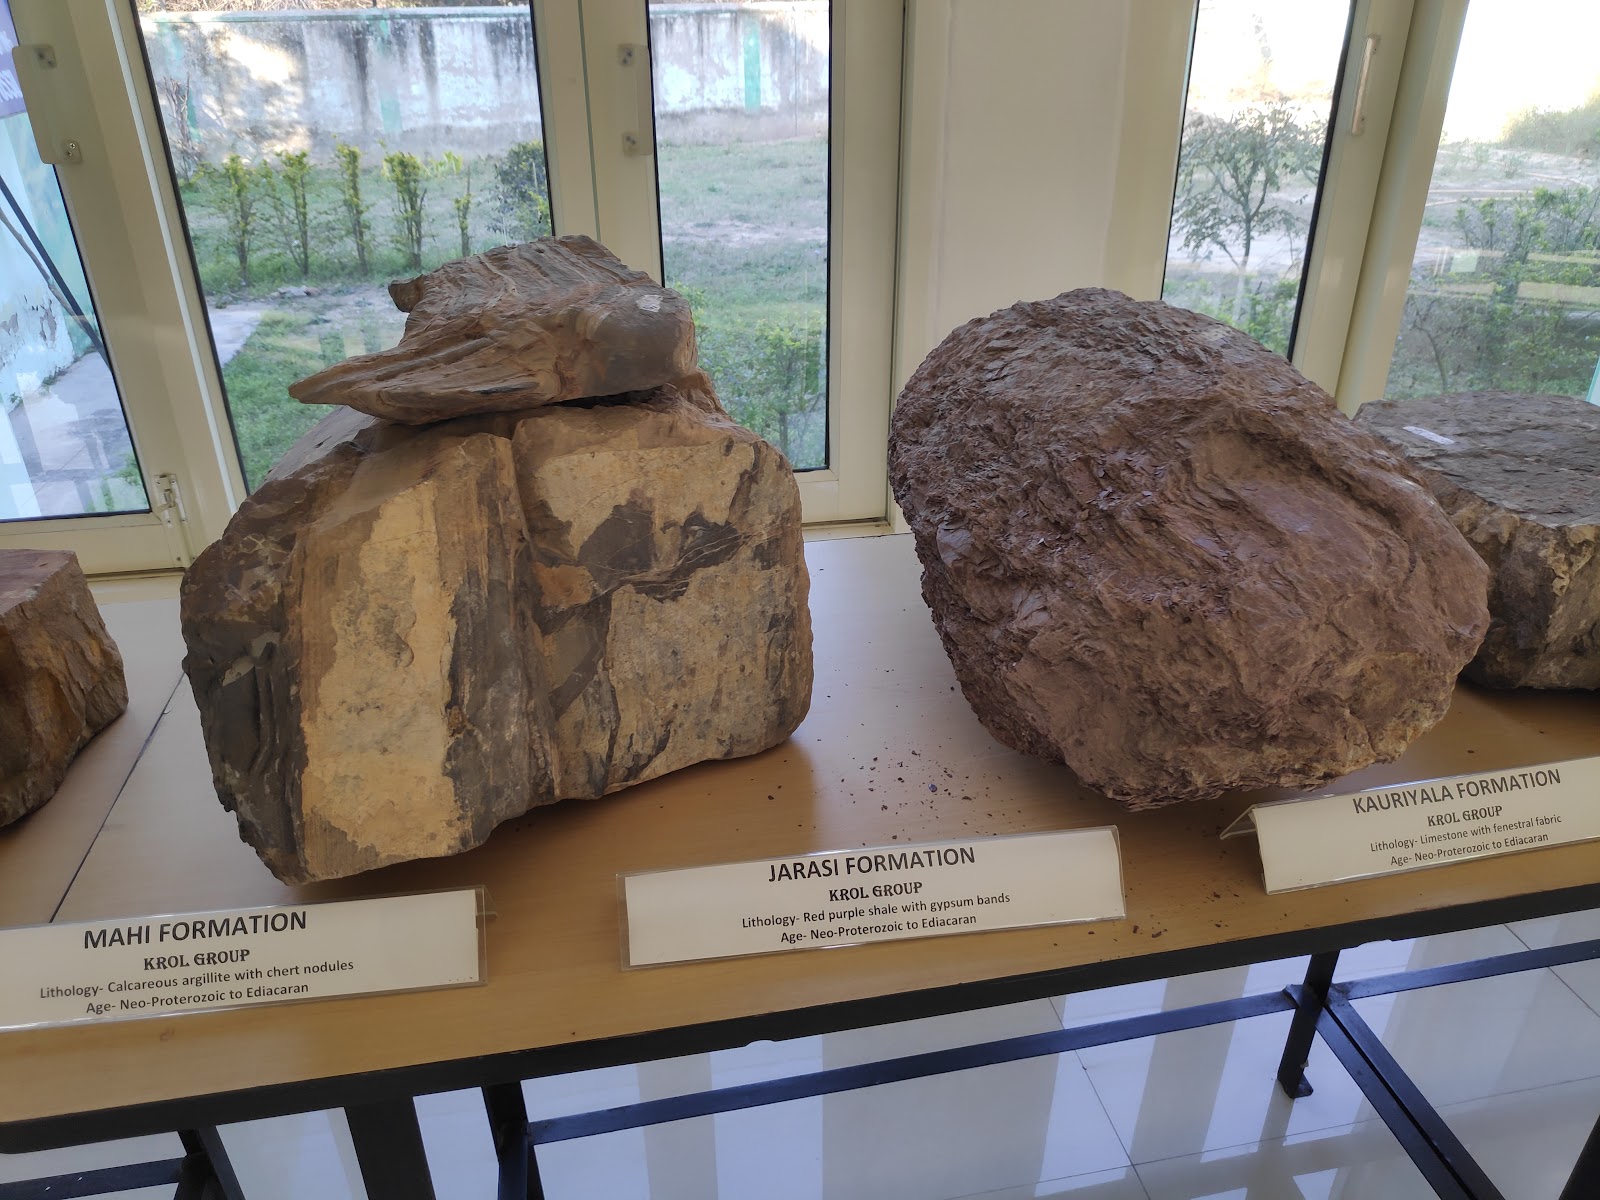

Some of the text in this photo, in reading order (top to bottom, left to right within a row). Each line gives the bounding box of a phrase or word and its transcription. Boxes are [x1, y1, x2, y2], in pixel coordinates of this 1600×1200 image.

[1353, 769, 1561, 814] KAURIYALA FORMATION
[1427, 805, 1502, 827] KROL GROUP
[1370, 814, 1562, 852] Lithology- Limestone with fenestral fabric
[769, 847, 975, 882] JARASI FORMATION
[1390, 834, 1549, 866] Age- Neo-Proterozoic to Ediacaran
[829, 882, 922, 902] KROL GROUP
[742, 893, 1010, 928] Lithology- Red purple shale with gypsum bands
[84, 911, 306, 949] MAHI FORMATION
[781, 916, 976, 944] Age- Neo-Proterozoic to Ediacaran
[144, 949, 250, 970] KROL GROUP
[40, 960, 354, 998] Lithology- Calcareous argillite with chert nodules
[86, 984, 308, 1015] Age- Neo-Proterozoic to Ediacaran
